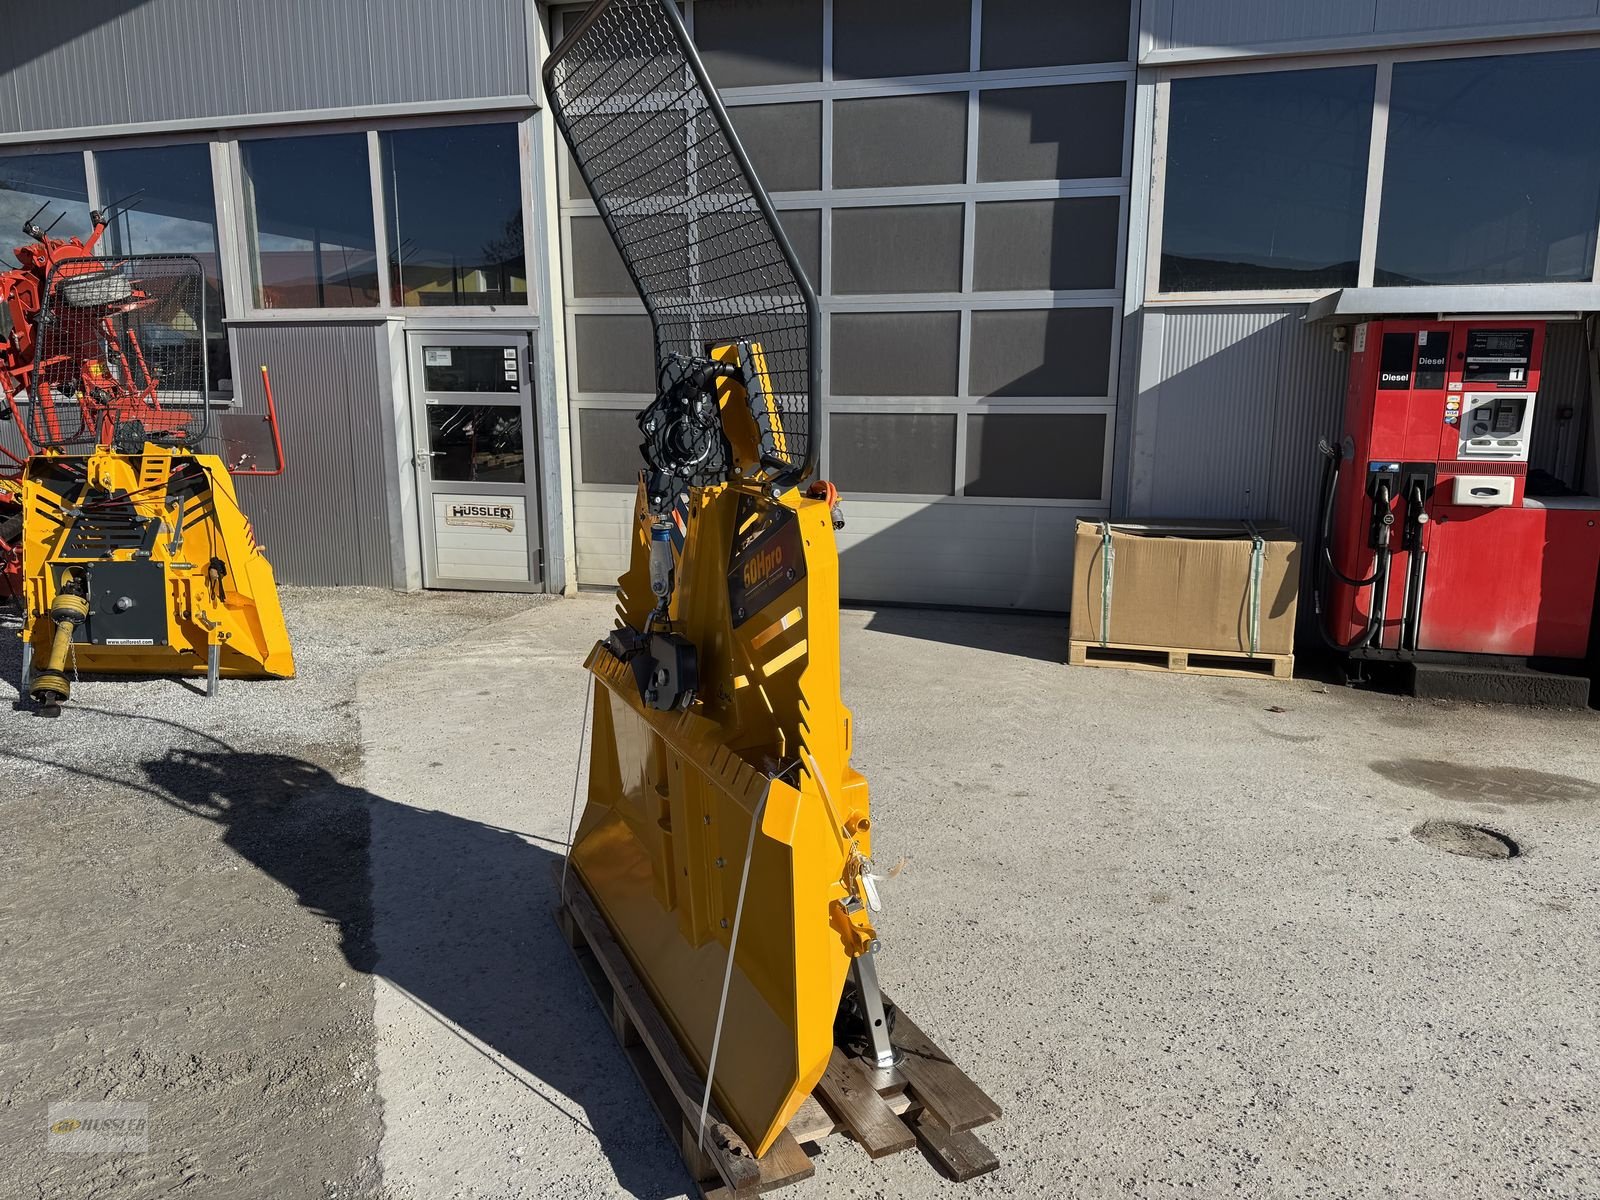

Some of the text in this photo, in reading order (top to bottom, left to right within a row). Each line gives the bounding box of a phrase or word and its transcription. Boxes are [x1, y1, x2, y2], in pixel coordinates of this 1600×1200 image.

[1419, 357, 1445, 365] Diesel
[1382, 373, 1409, 381] Diesel
[1514, 369, 1520, 379] 1
